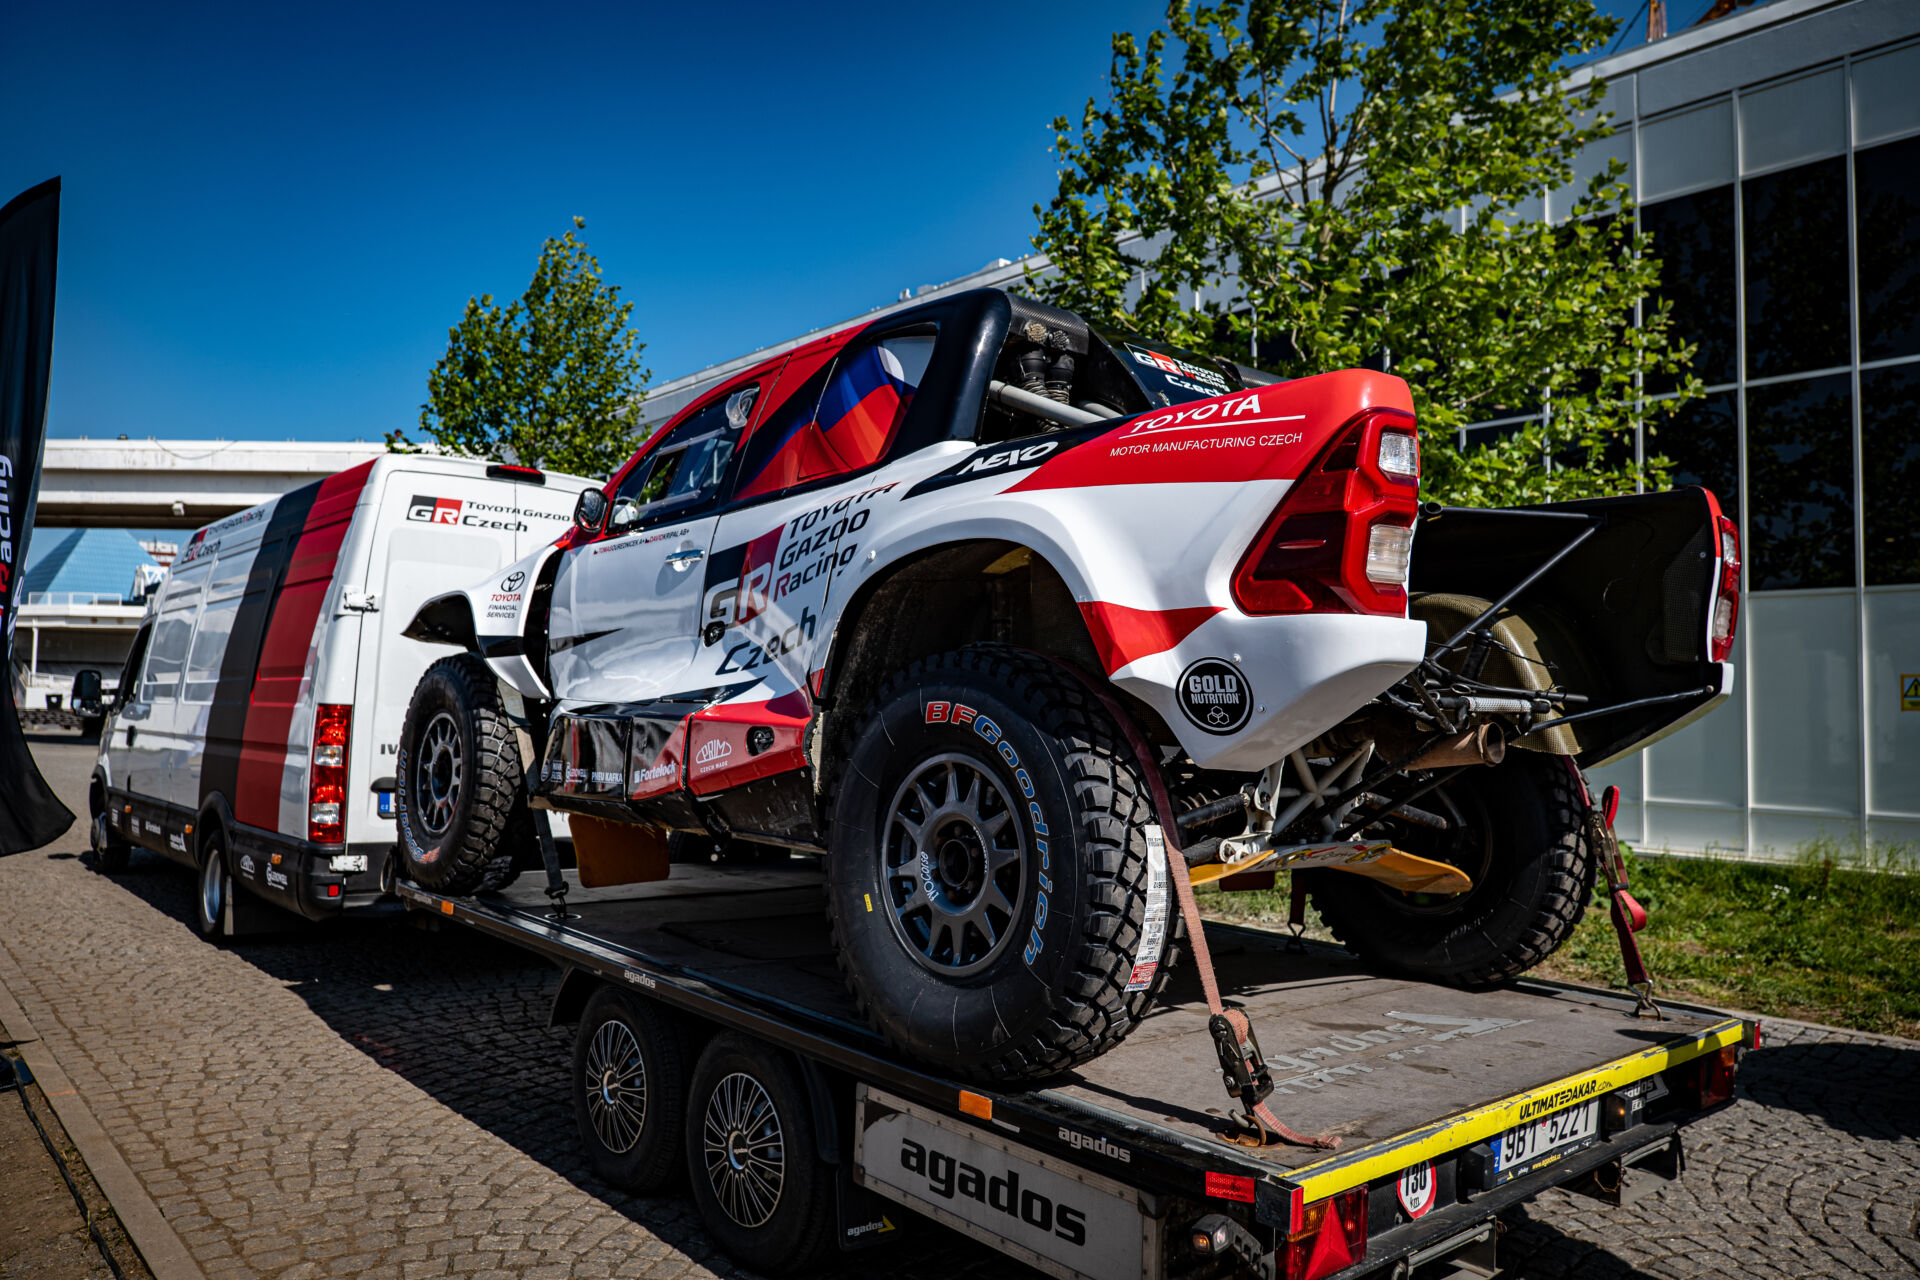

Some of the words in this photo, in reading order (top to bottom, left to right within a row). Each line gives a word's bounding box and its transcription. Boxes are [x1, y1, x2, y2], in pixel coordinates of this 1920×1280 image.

[1172, 357, 1225, 380] TOYOTA
[1179, 365, 1226, 385] GAZOO
[1164, 373, 1225, 398] Czech
[1183, 371, 1231, 393] Racing
[1130, 393, 1262, 434] TOYOTA
[1110, 443, 1151, 457] MOTOR
[1152, 436, 1257, 453] MANUFACTURING
[1259, 431, 1303, 446] CZECH
[407, 503, 460, 525] GR
[789, 481, 901, 540] TOYOTA
[462, 514, 529, 532] Czech
[778, 508, 871, 572] GAZOO
[773, 543, 858, 603] Racing
[490, 593, 521, 602] TOYOTA
[715, 605, 817, 676] Czech
[1188, 674, 1238, 693] GOLD
[1190, 693, 1241, 705] NUTRITION
[639, 760, 677, 782] Fortelock
[925, 700, 1053, 966] BFGoodrich
[624, 969, 657, 989] agados
[1058, 1126, 1131, 1163] agados
[1504, 1119, 1537, 1163] 9B1
[1549, 1103, 1590, 1145] 5221
[1405, 1160, 1427, 1197] 130
[900, 1137, 1106, 1247] agados
[1409, 1196, 1421, 1209] km
[847, 1221, 885, 1237] agados
